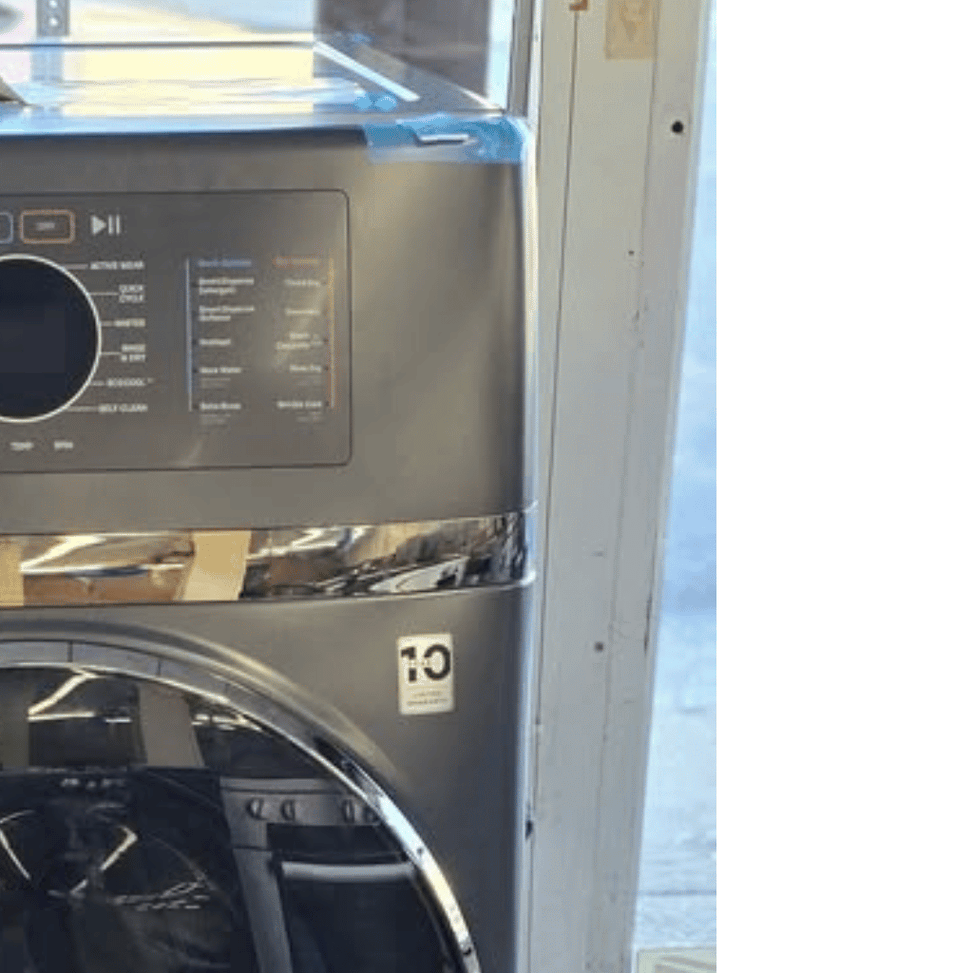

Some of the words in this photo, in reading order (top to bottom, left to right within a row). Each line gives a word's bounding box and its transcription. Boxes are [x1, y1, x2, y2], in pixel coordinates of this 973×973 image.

[90, 261, 118, 270] ACTIVE
[120, 261, 145, 270] WEAR
[401, 644, 451, 683] 10
